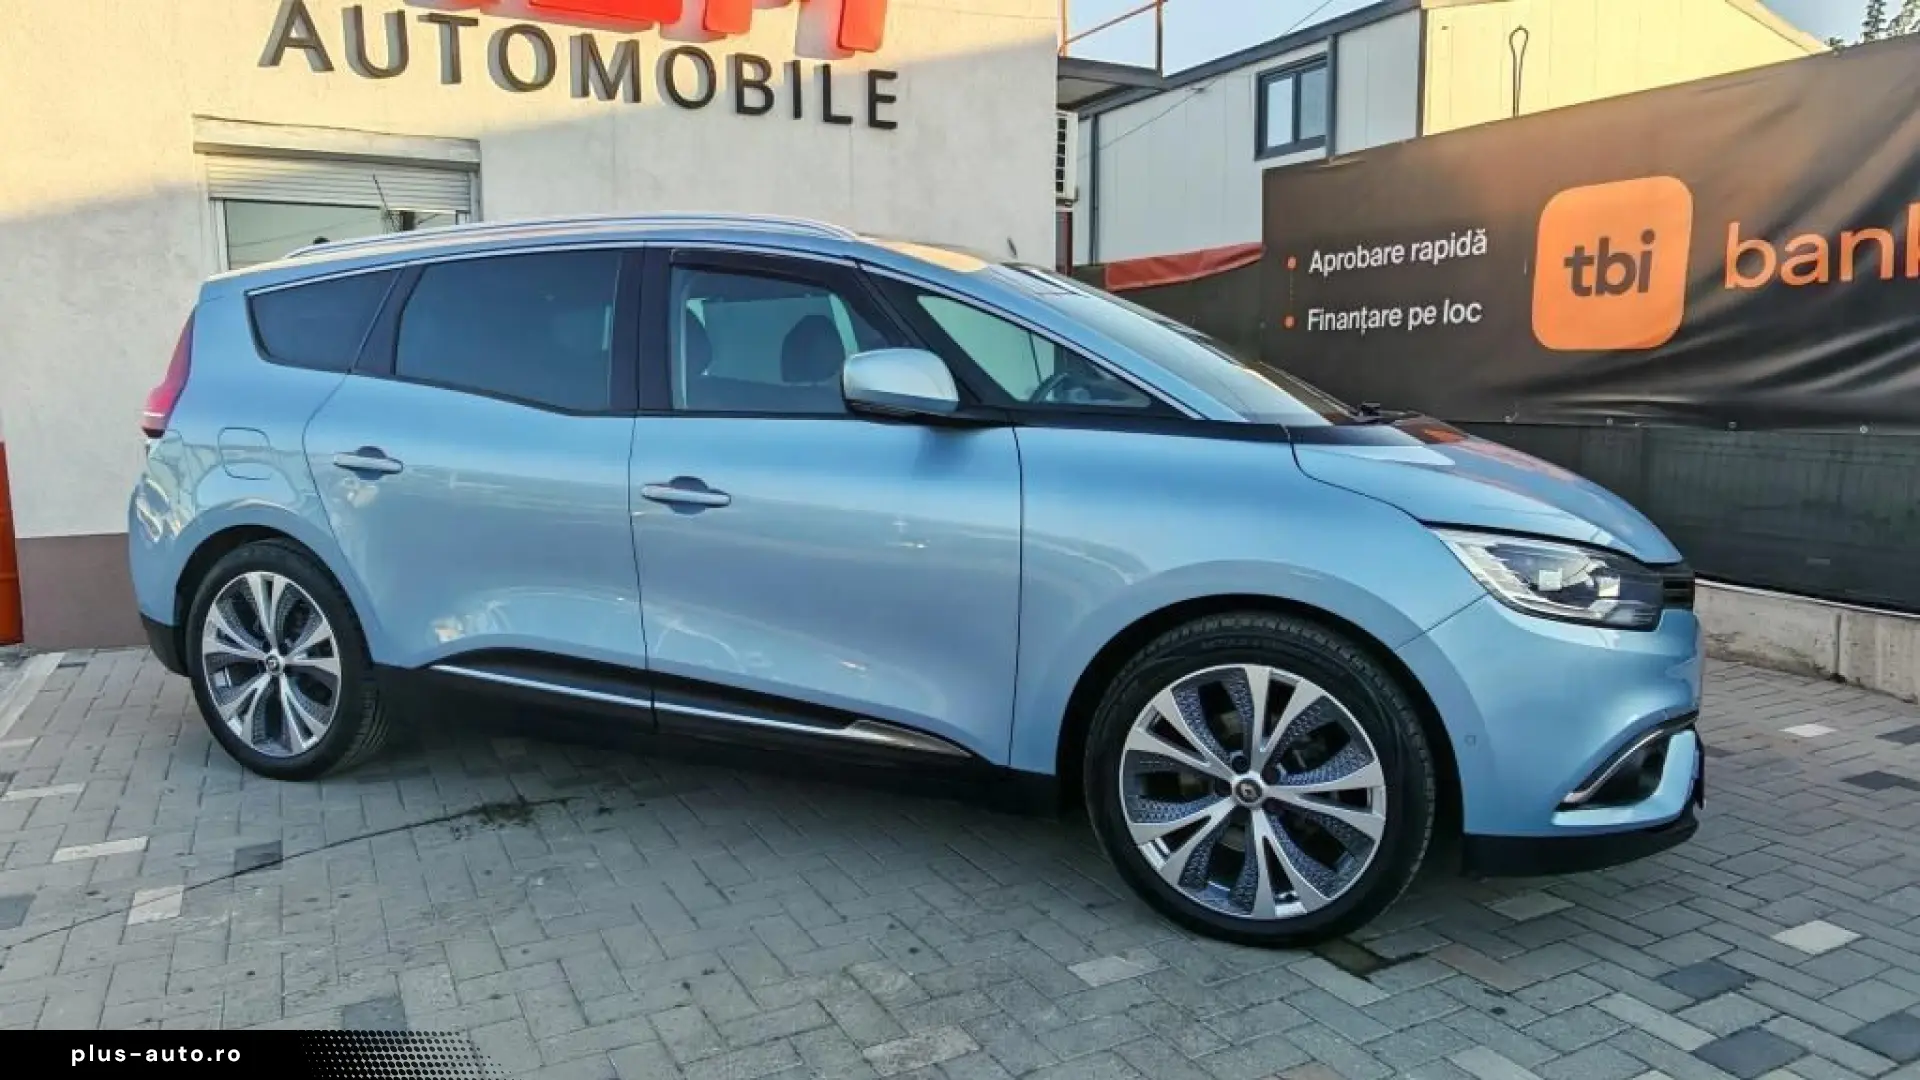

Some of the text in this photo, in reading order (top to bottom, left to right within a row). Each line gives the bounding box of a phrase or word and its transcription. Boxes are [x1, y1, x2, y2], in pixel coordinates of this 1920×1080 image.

[258, 0, 898, 130] AUTOMOBILE
[1309, 228, 1488, 277] Aprobare rapidă
[1564, 230, 1656, 297] tbi
[1308, 298, 1483, 336] Finanțare pe loc
